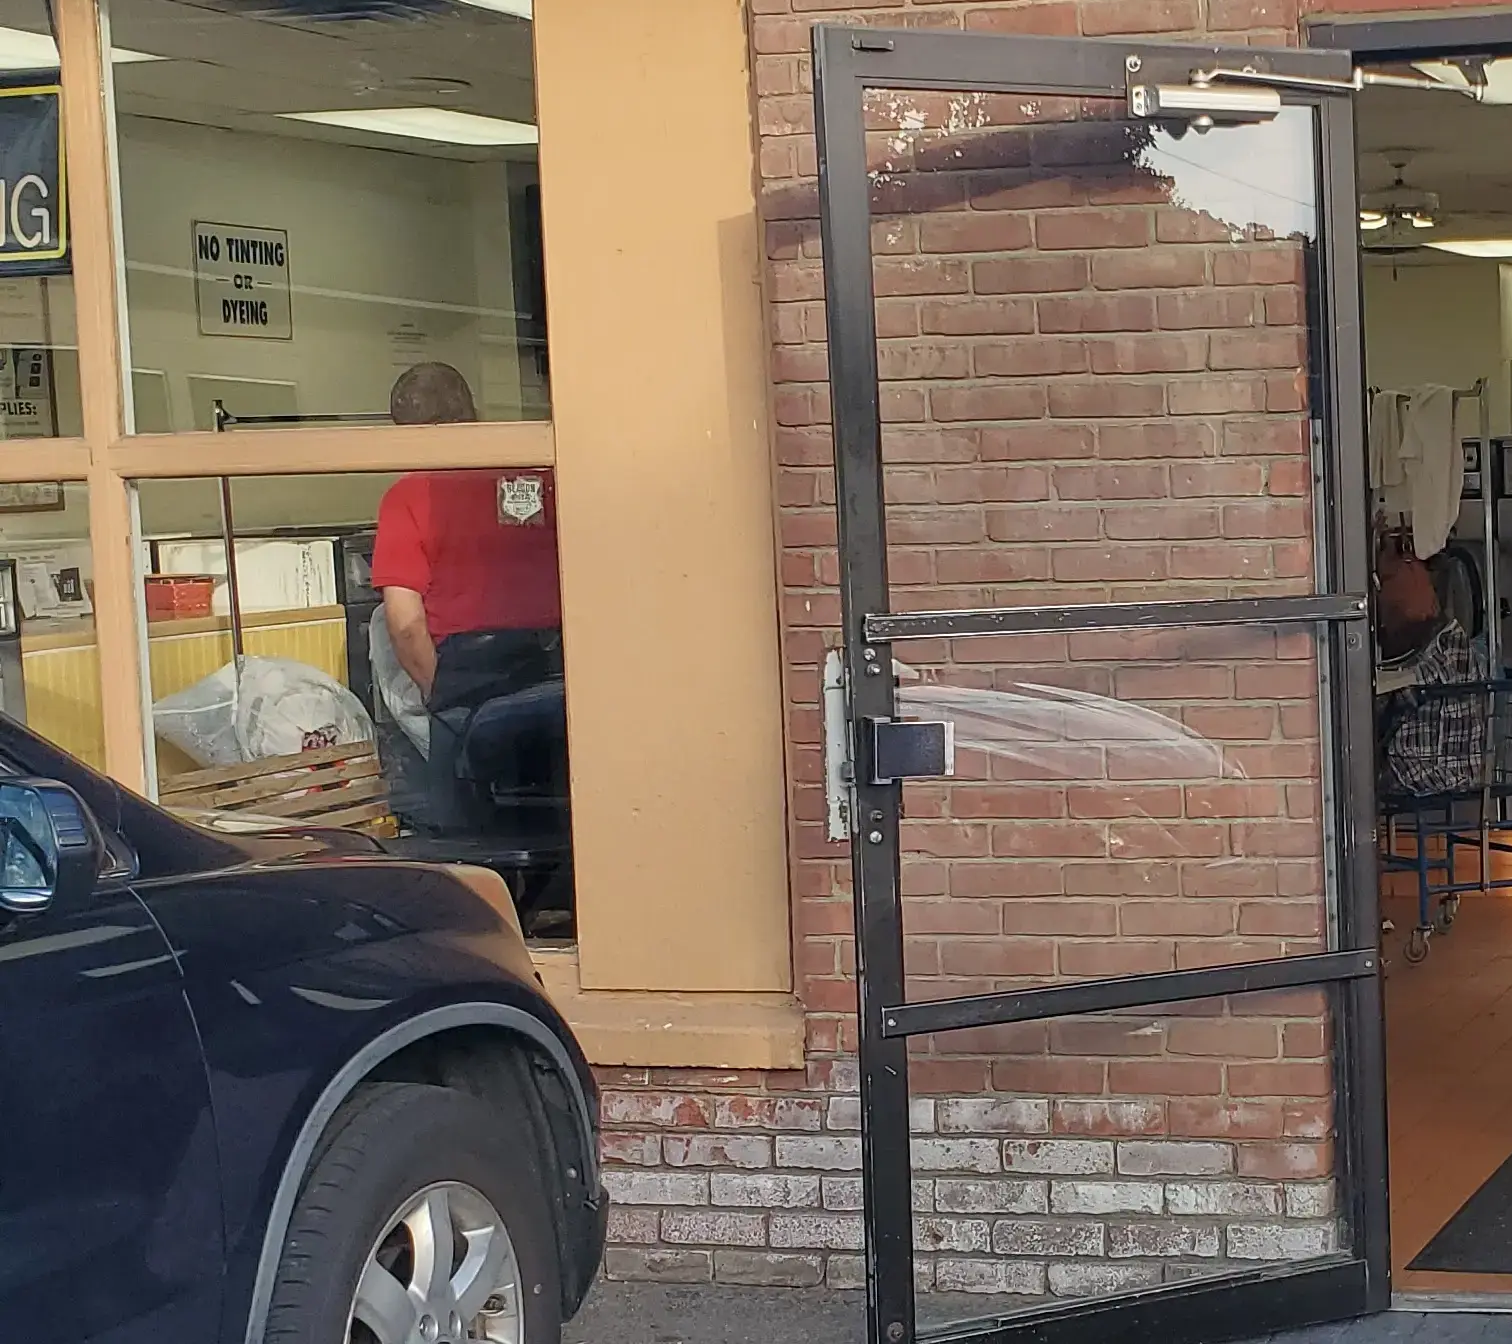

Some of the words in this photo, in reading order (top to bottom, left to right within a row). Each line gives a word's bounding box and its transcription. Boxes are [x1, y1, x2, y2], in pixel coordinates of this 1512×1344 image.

[0, 175, 49, 248] G
[198, 235, 220, 261] NO
[226, 237, 285, 267] TINTING
[233, 274, 253, 289] OR
[222, 299, 268, 325] DYEING
